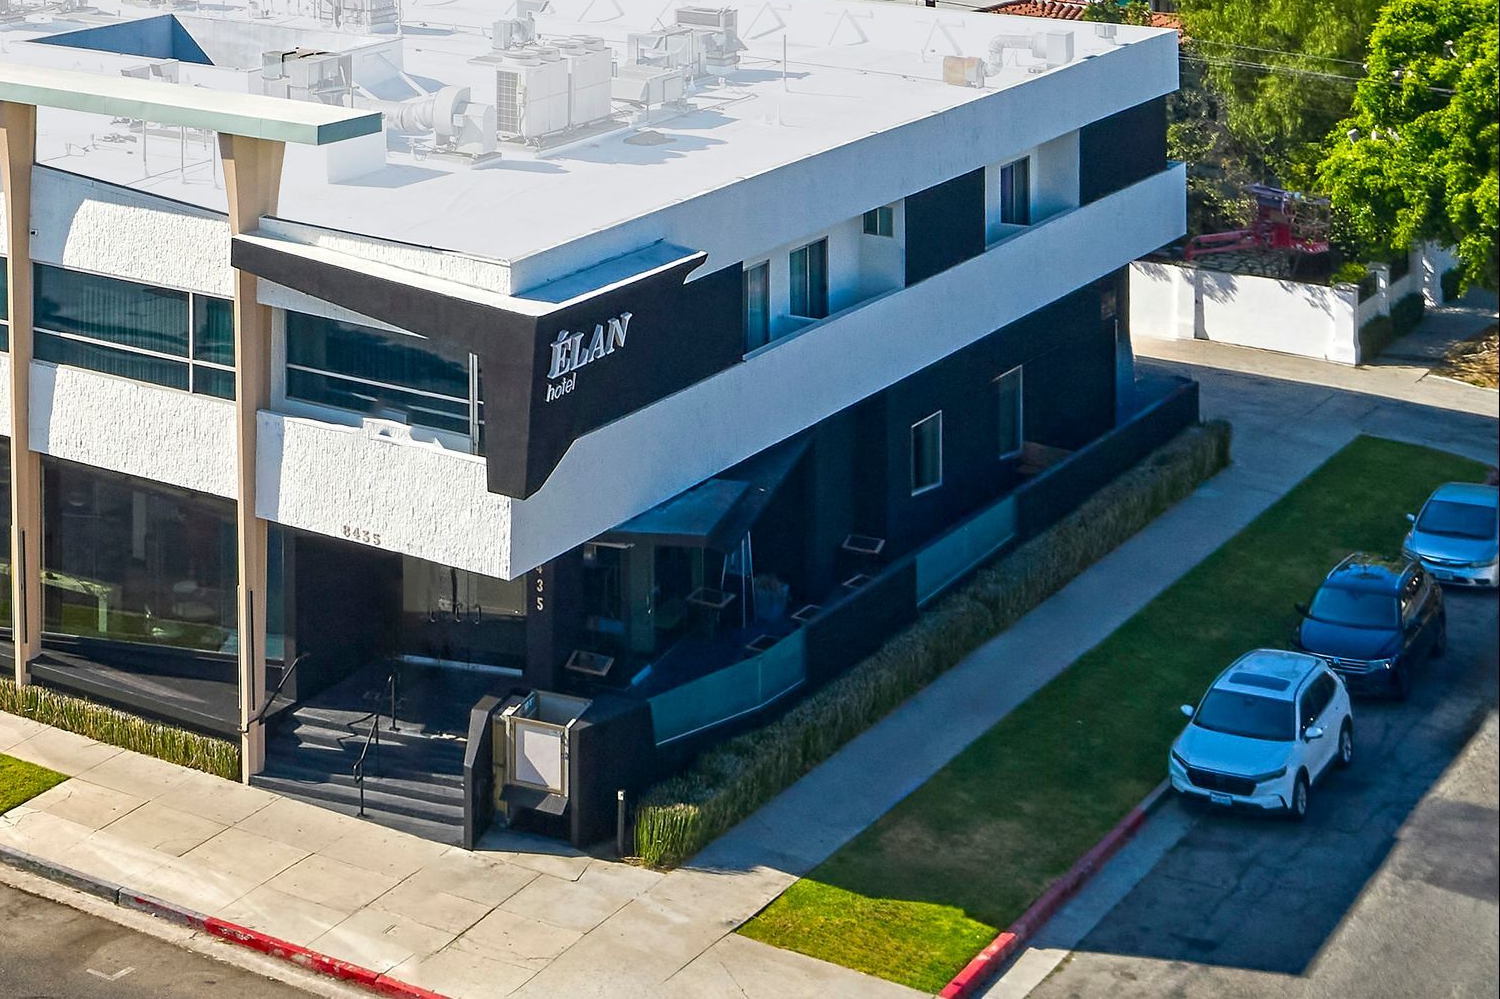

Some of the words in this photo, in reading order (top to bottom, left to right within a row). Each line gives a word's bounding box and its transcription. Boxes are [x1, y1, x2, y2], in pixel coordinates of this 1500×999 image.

[547, 312, 633, 379] ÉLAN
[546, 372, 576, 402] hotel
[343, 524, 381, 546] 8435
